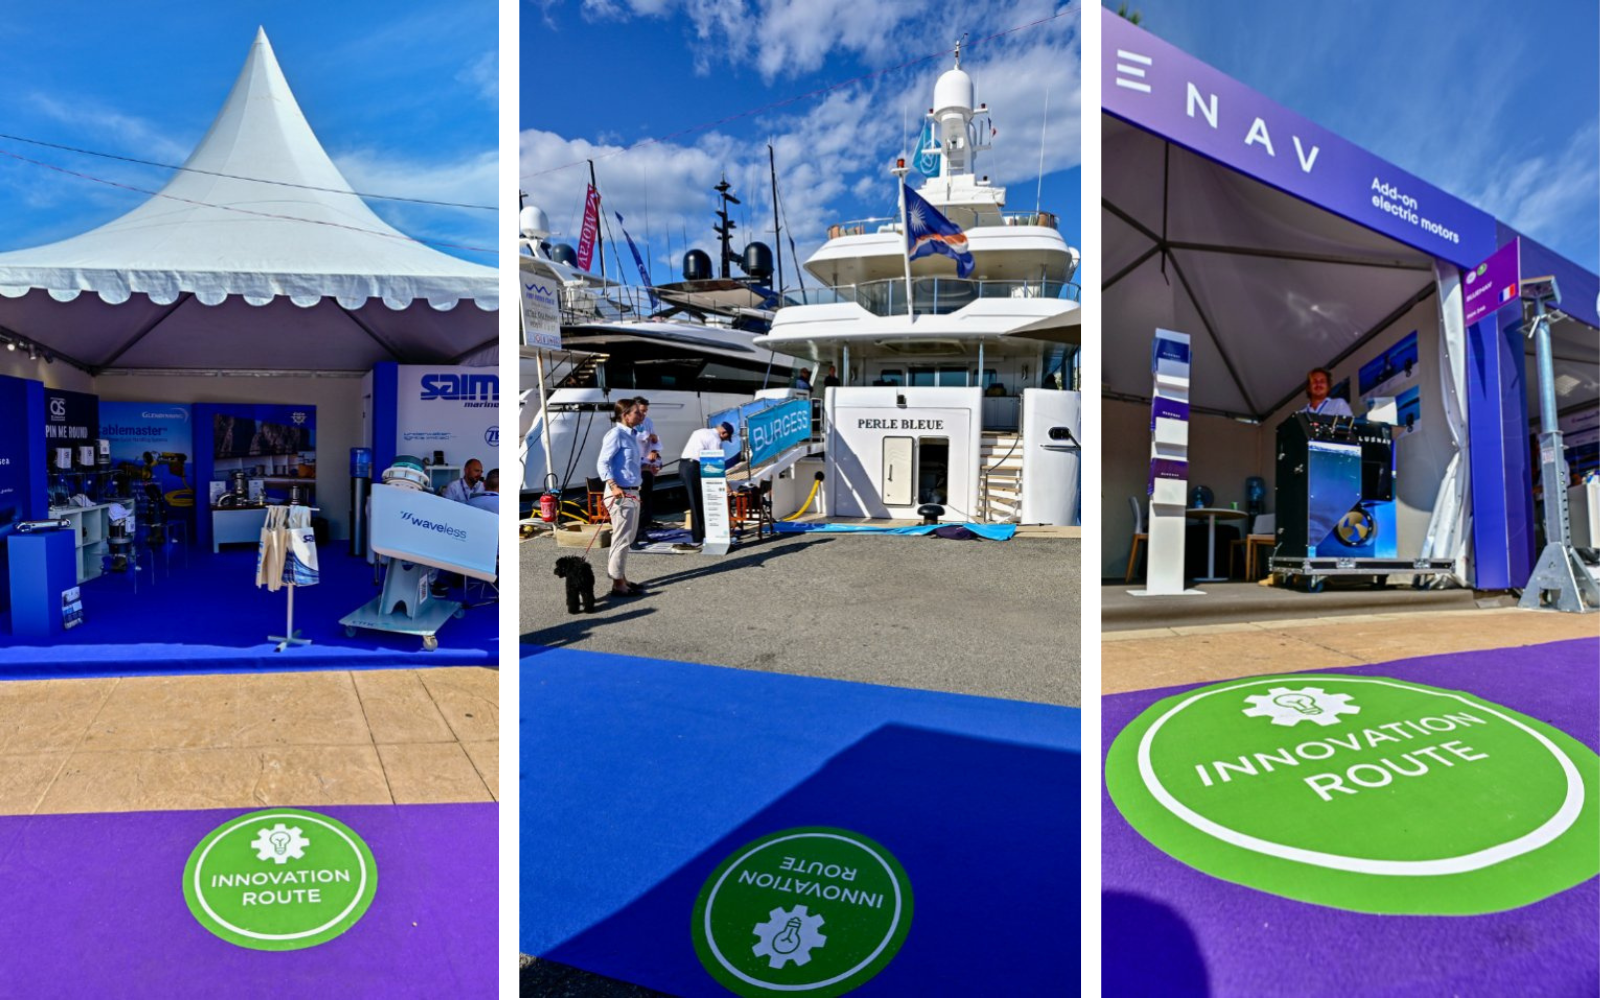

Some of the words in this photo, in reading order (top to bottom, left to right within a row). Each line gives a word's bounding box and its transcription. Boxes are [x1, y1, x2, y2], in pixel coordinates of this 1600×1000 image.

[1371, 177, 1418, 210] Add-on
[1372, 195, 1419, 225] electric
[1420, 217, 1460, 244] motors
[58, 425, 68, 439] ME
[753, 410, 808, 451] BURGESS
[857, 418, 898, 429] PERLE
[901, 419, 944, 430] BLEUE
[411, 517, 467, 539] waveless
[1195, 712, 1488, 787] INNOVATION
[1303, 740, 1490, 802] ROUTE
[211, 869, 351, 888] INNOVATION
[779, 856, 857, 881] ROUTE
[242, 889, 321, 906] ROUTE
[738, 870, 884, 908] INNOVATION
